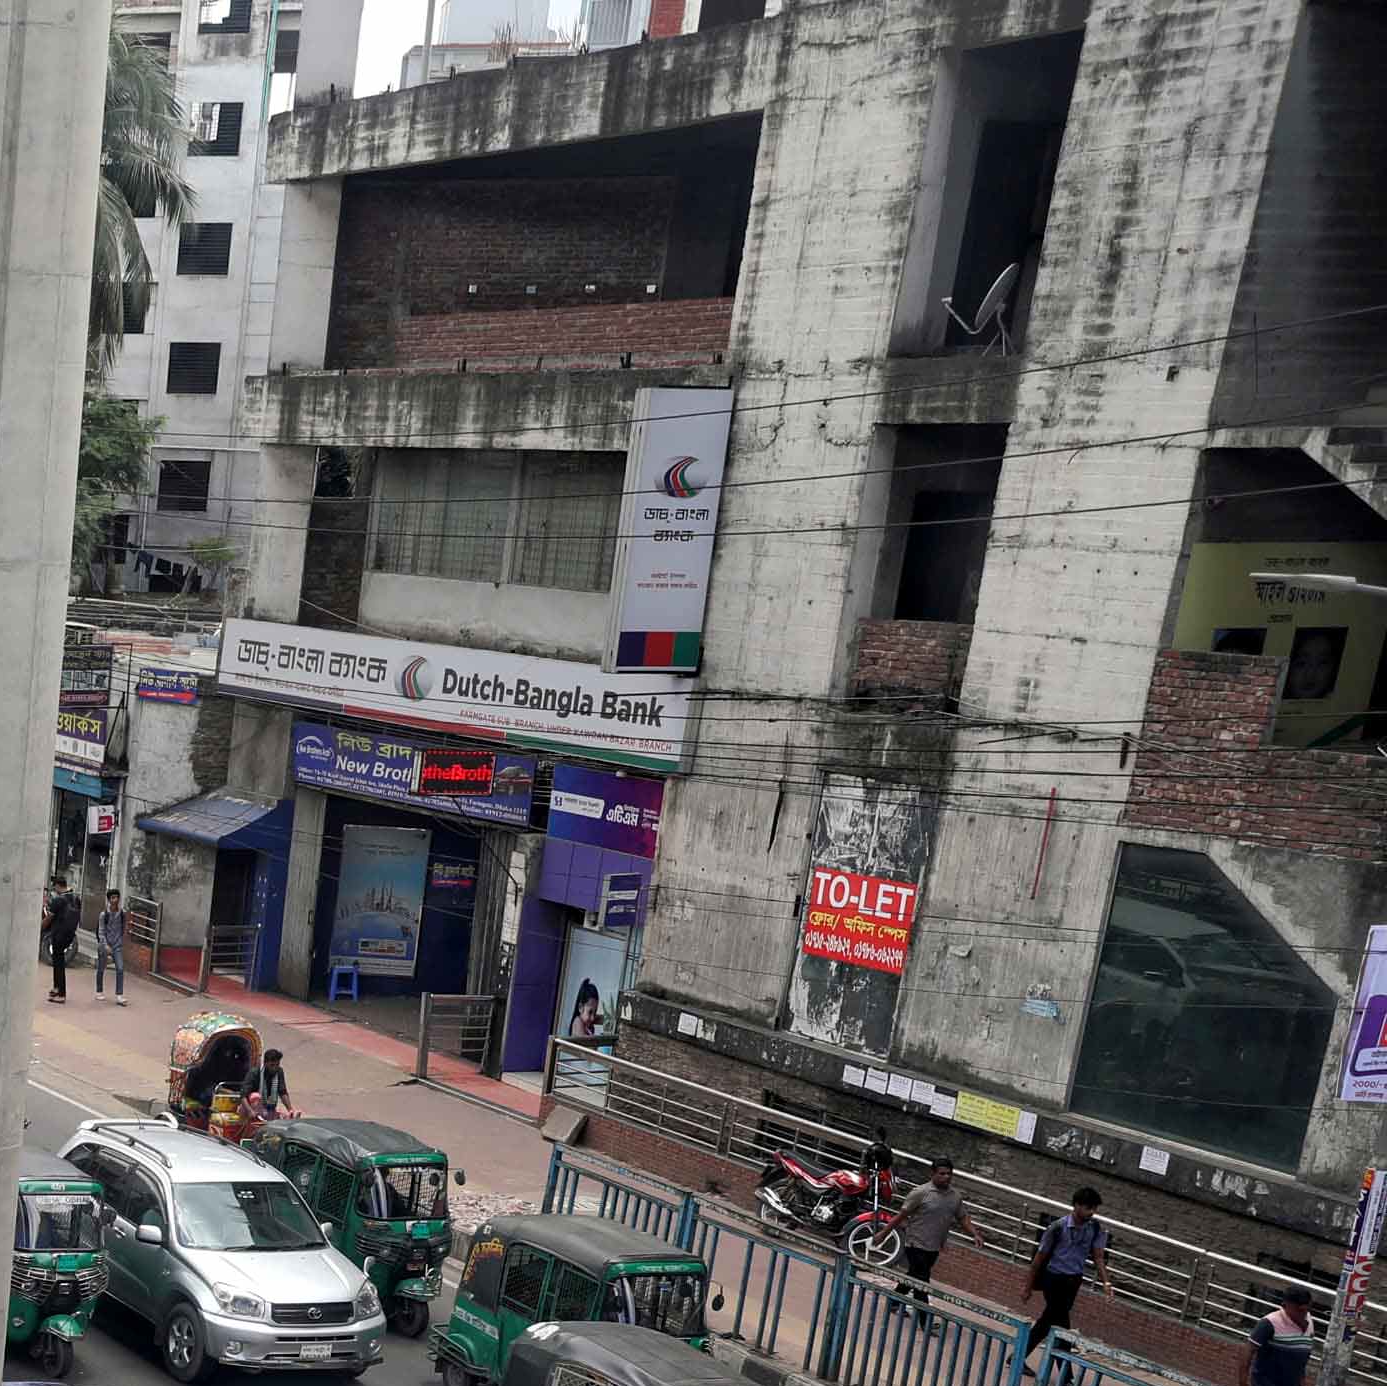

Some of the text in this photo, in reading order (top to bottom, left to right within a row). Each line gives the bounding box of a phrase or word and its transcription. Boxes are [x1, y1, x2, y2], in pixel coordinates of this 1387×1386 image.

[653, 529, 695, 542] ব্যাংক
[329, 651, 387, 684] ব্যাংক
[442, 668, 664, 728] Dutch-Bangla Bank
[336, 732, 373, 751] নিউ
[547, 724, 572, 735] UNDER
[610, 735, 635, 748] BAZAR
[639, 740, 672, 752] BRANCH
[335, 754, 369, 775] New
[606, 804, 639, 826] এটিএম
[814, 871, 915, 921] TO-LET
[843, 915, 875, 936] অফিস
[878, 924, 908, 943] স্পেস
